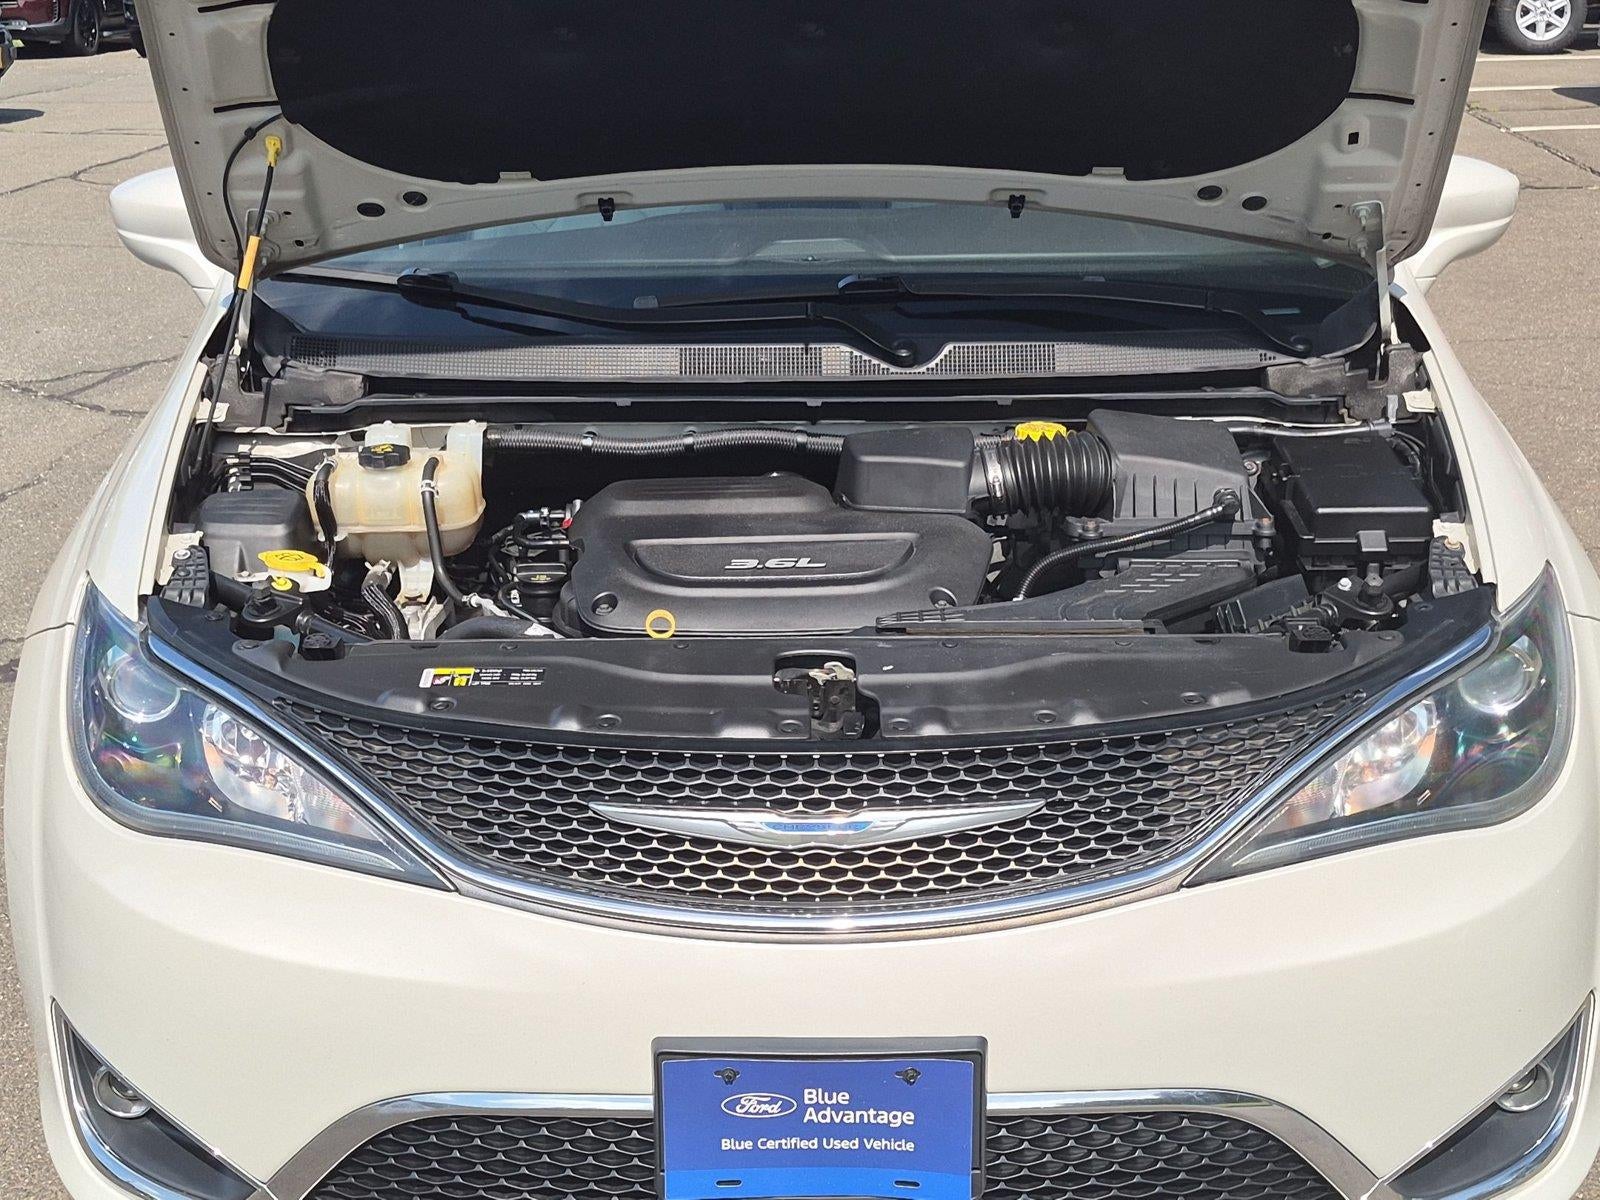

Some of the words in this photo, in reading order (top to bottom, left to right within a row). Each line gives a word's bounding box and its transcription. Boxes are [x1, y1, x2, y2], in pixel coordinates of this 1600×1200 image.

[724, 557, 827, 569] 3.6L
[735, 1096, 782, 1114] Ford
[803, 1088, 850, 1105] Blue
[803, 1107, 915, 1128] Advantage
[721, 1138, 753, 1150] Blue
[757, 1138, 818, 1150] Certified
[823, 1138, 859, 1150] Used
[863, 1138, 915, 1152] Vehicle
